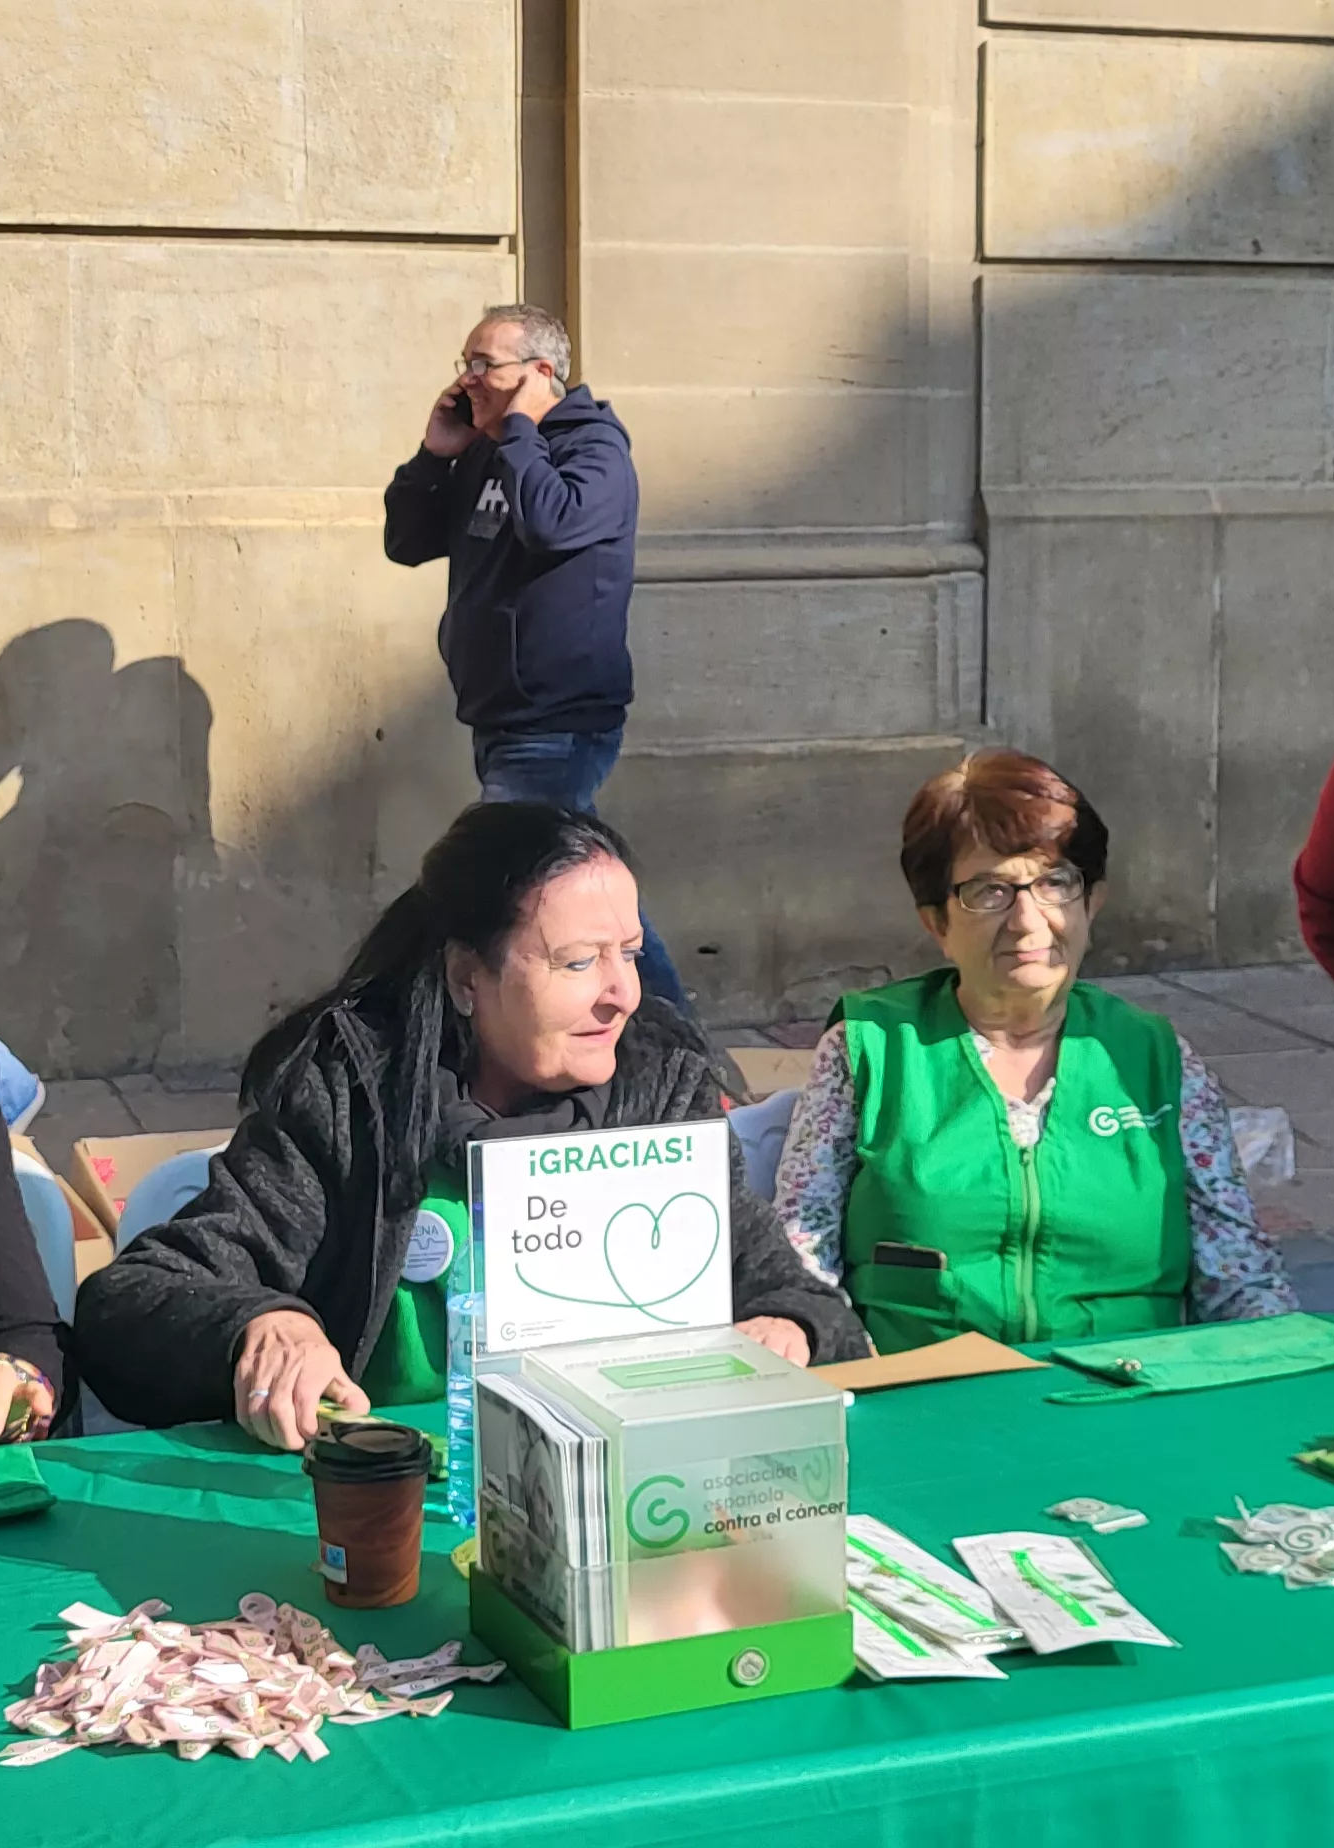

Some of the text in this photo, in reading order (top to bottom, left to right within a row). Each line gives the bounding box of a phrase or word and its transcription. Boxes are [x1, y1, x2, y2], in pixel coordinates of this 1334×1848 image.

[529, 1136, 693, 1176] ¡GRACIAS!
[527, 1196, 568, 1220] De
[511, 1224, 582, 1254] todo
[703, 1465, 798, 1491] asociación
[703, 1487, 785, 1513] española
[704, 1500, 846, 1534] contra el cáncer
